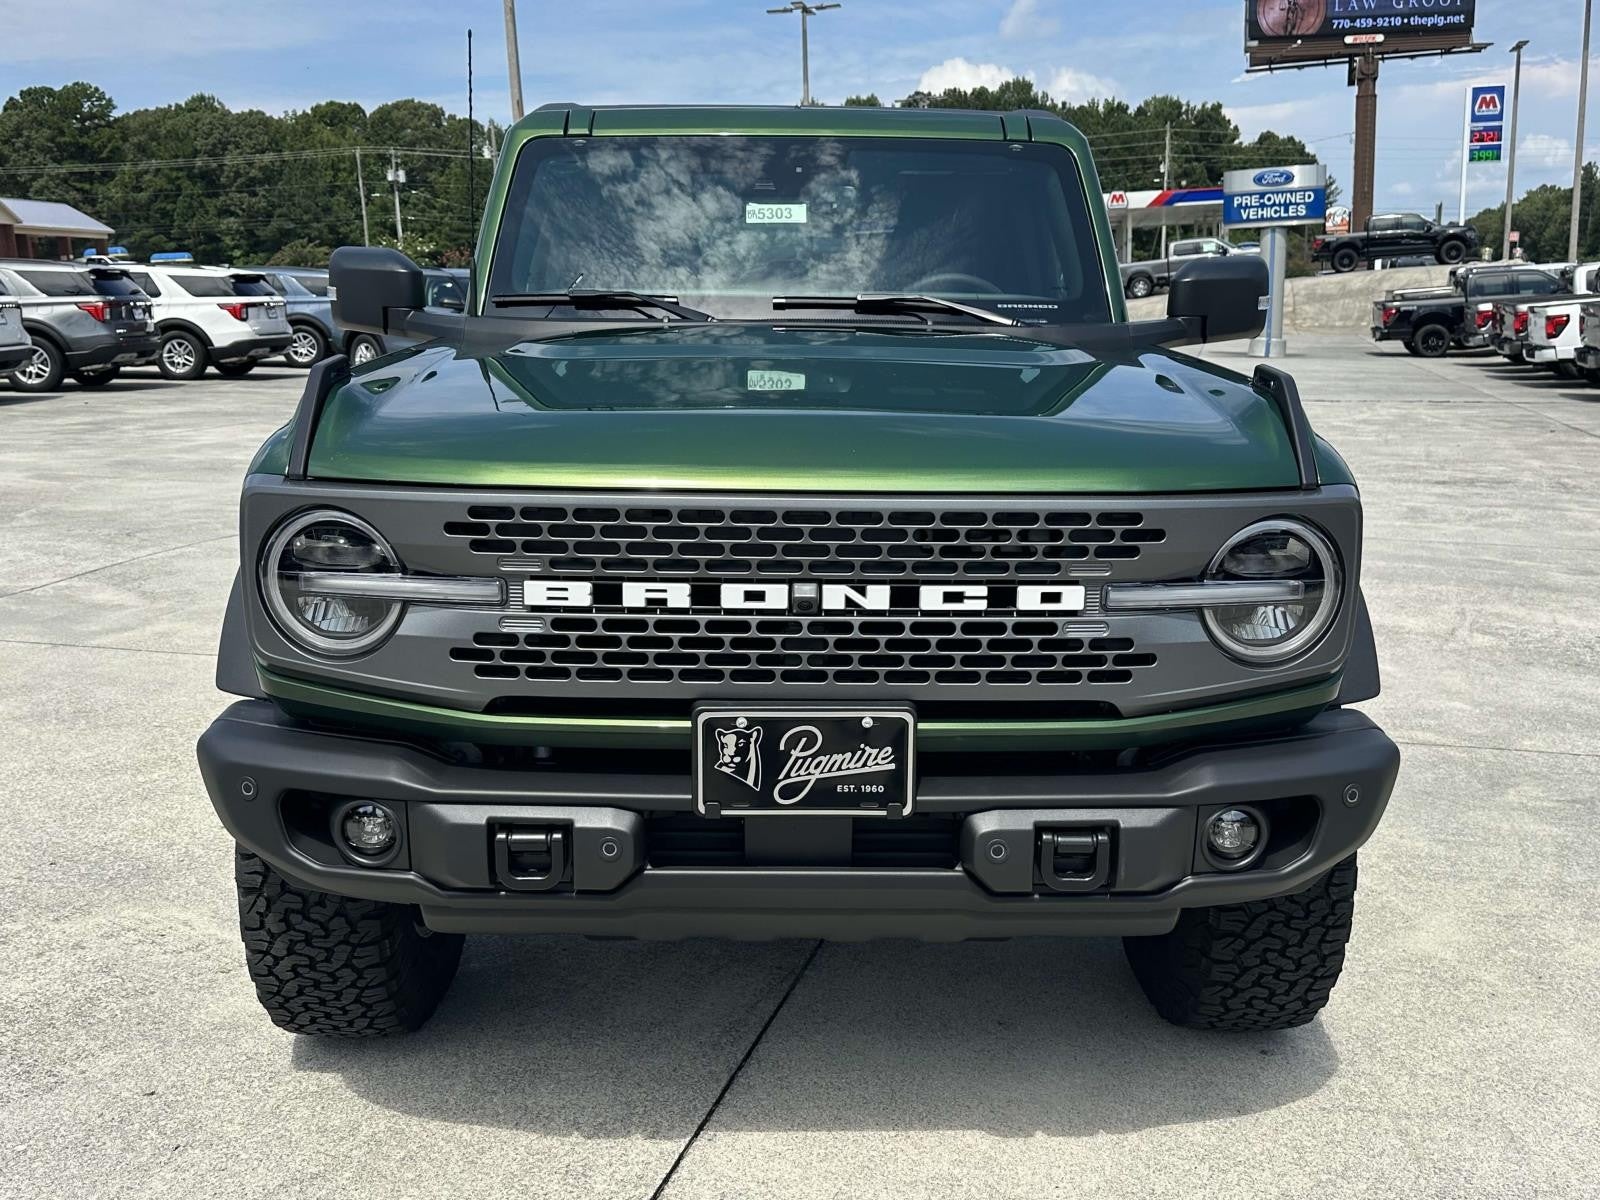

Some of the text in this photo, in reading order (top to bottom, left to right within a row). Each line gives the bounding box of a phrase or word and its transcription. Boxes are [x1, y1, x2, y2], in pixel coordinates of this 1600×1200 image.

[1334, 0, 1377, 12] LAW
[1332, 16, 1402, 29] 770-459-9210
[1261, 173, 1286, 184] Ford
[1233, 191, 1315, 208] PRE-OWNED
[1240, 205, 1307, 220] VEHICLES
[523, 579, 1087, 612] BRONCO
[773, 725, 896, 805] Pugmire
[836, 783, 885, 793] EST. 1960
